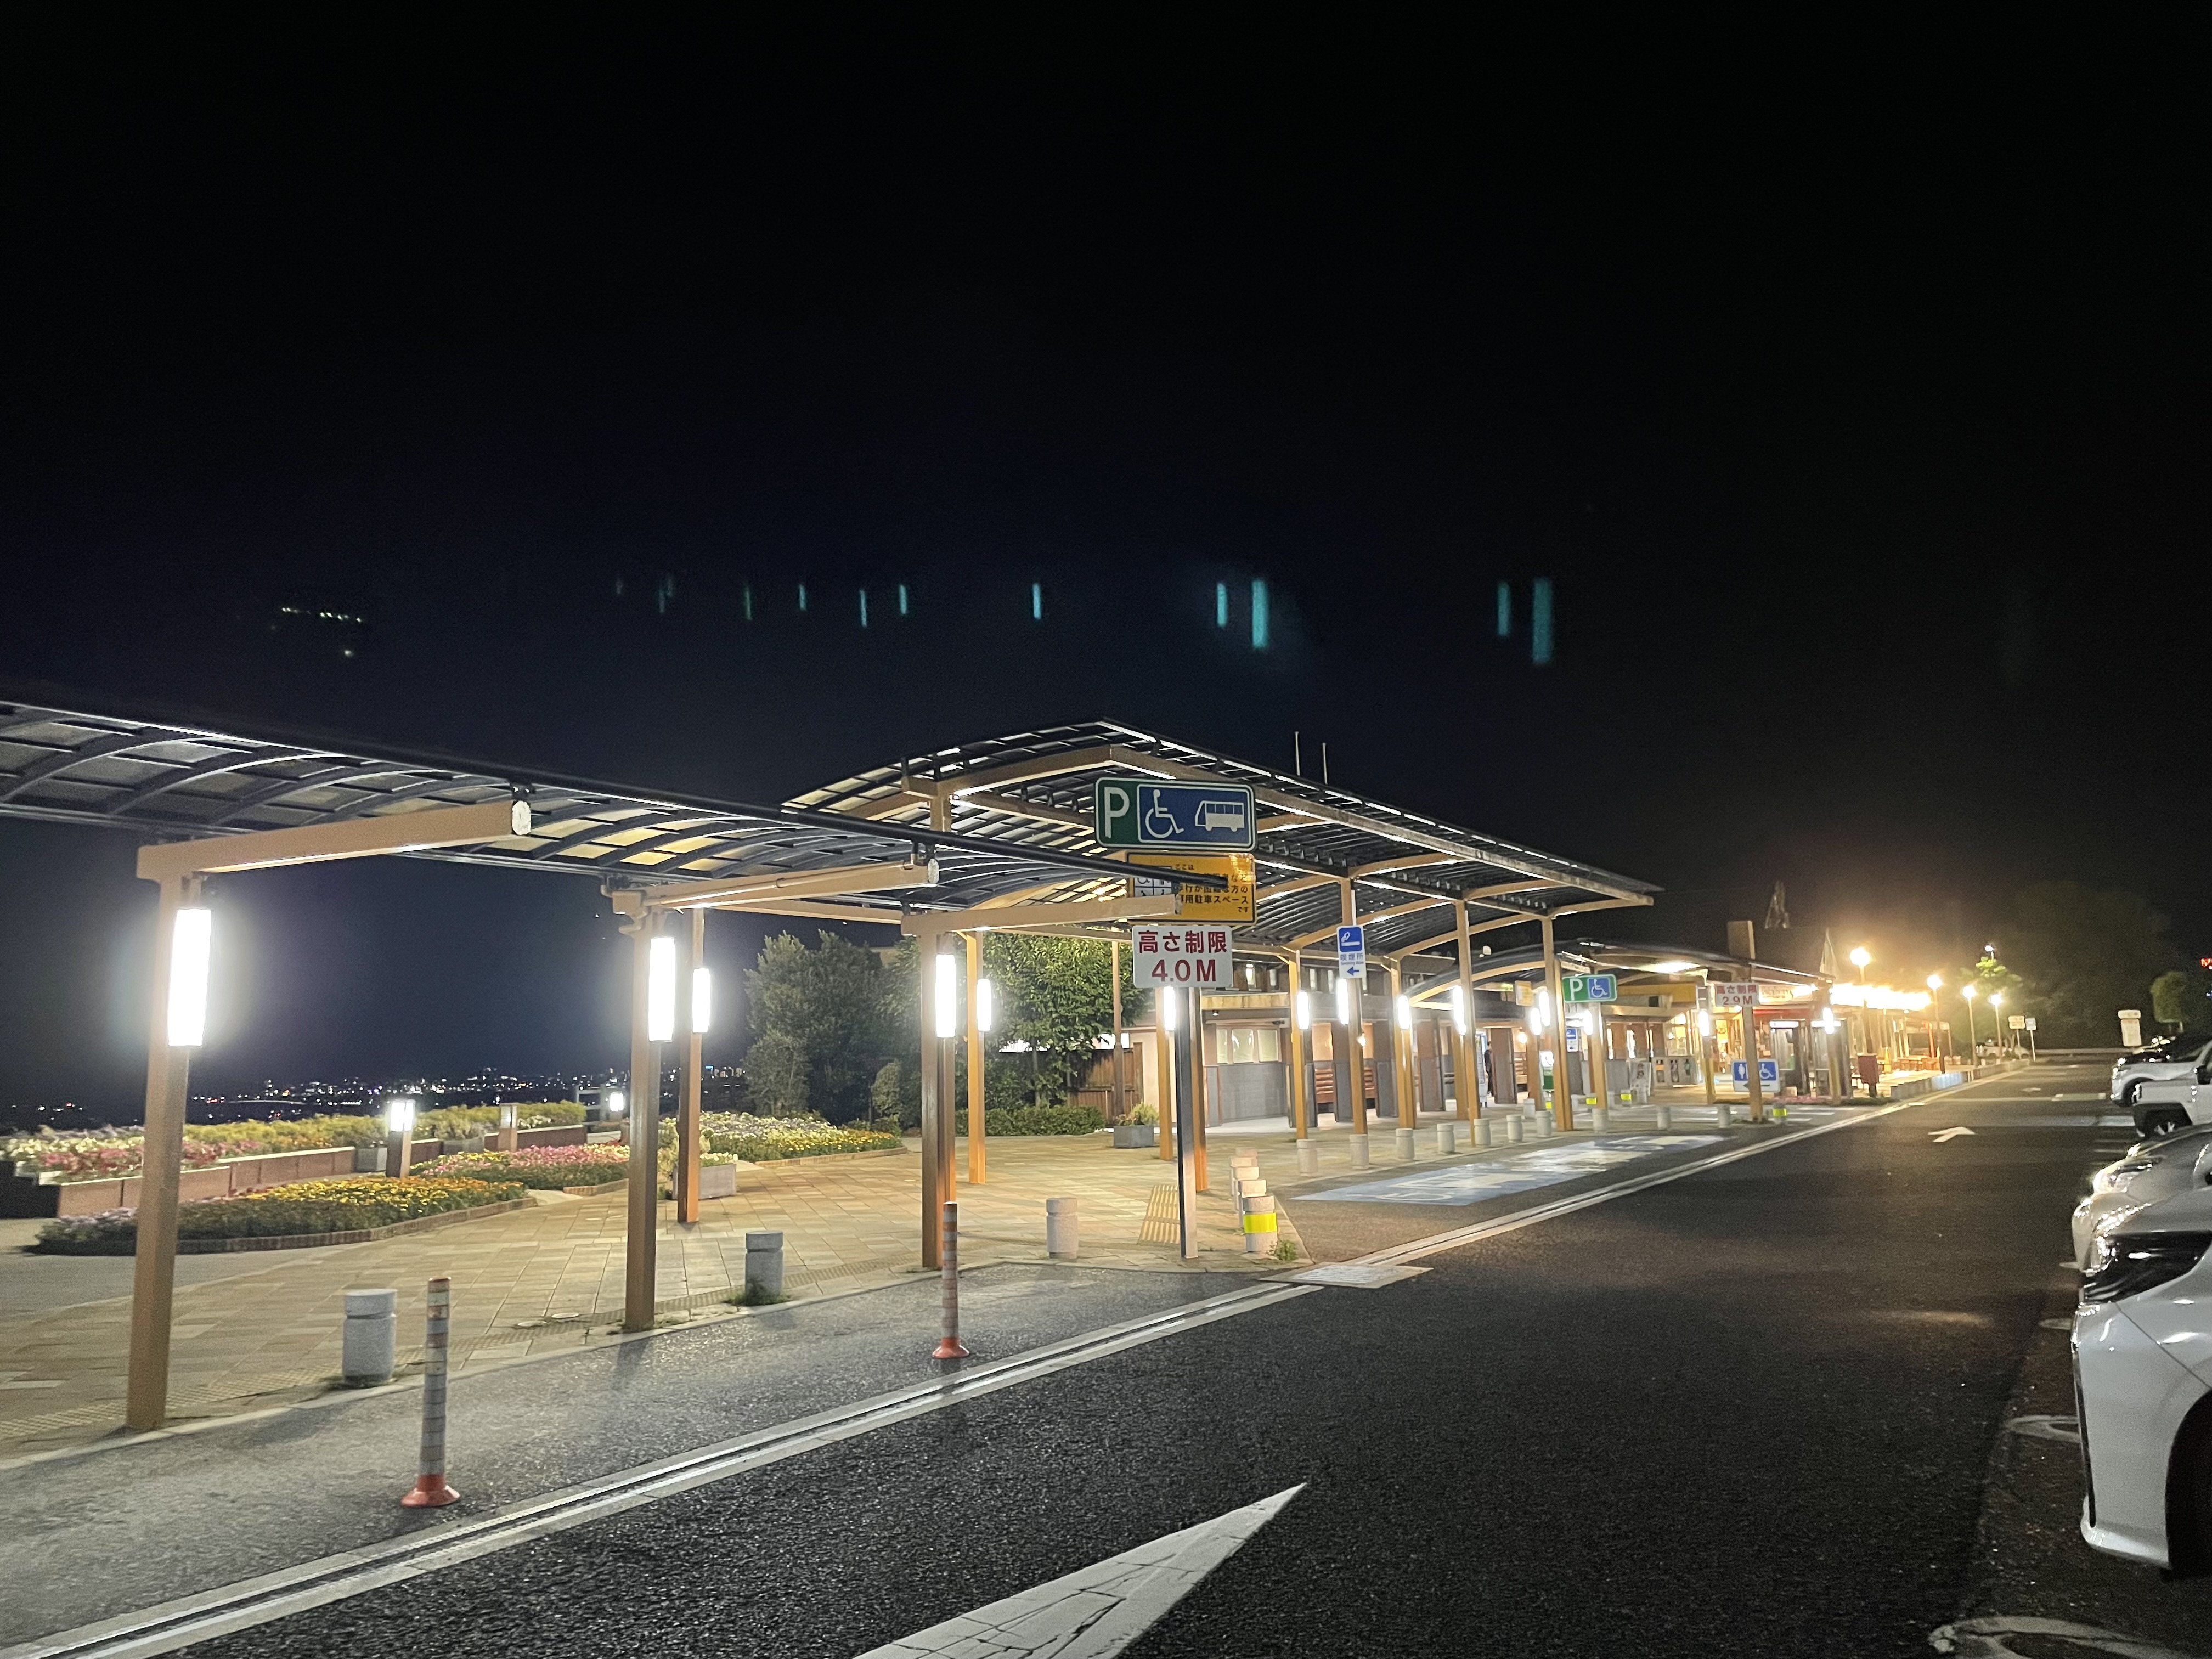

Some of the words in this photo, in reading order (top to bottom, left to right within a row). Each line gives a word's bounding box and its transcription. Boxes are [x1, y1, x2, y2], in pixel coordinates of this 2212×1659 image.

[1104, 787, 1130, 839] P
[1138, 930, 1227, 953] 高さ制限
[1569, 978, 1583, 1001] P
